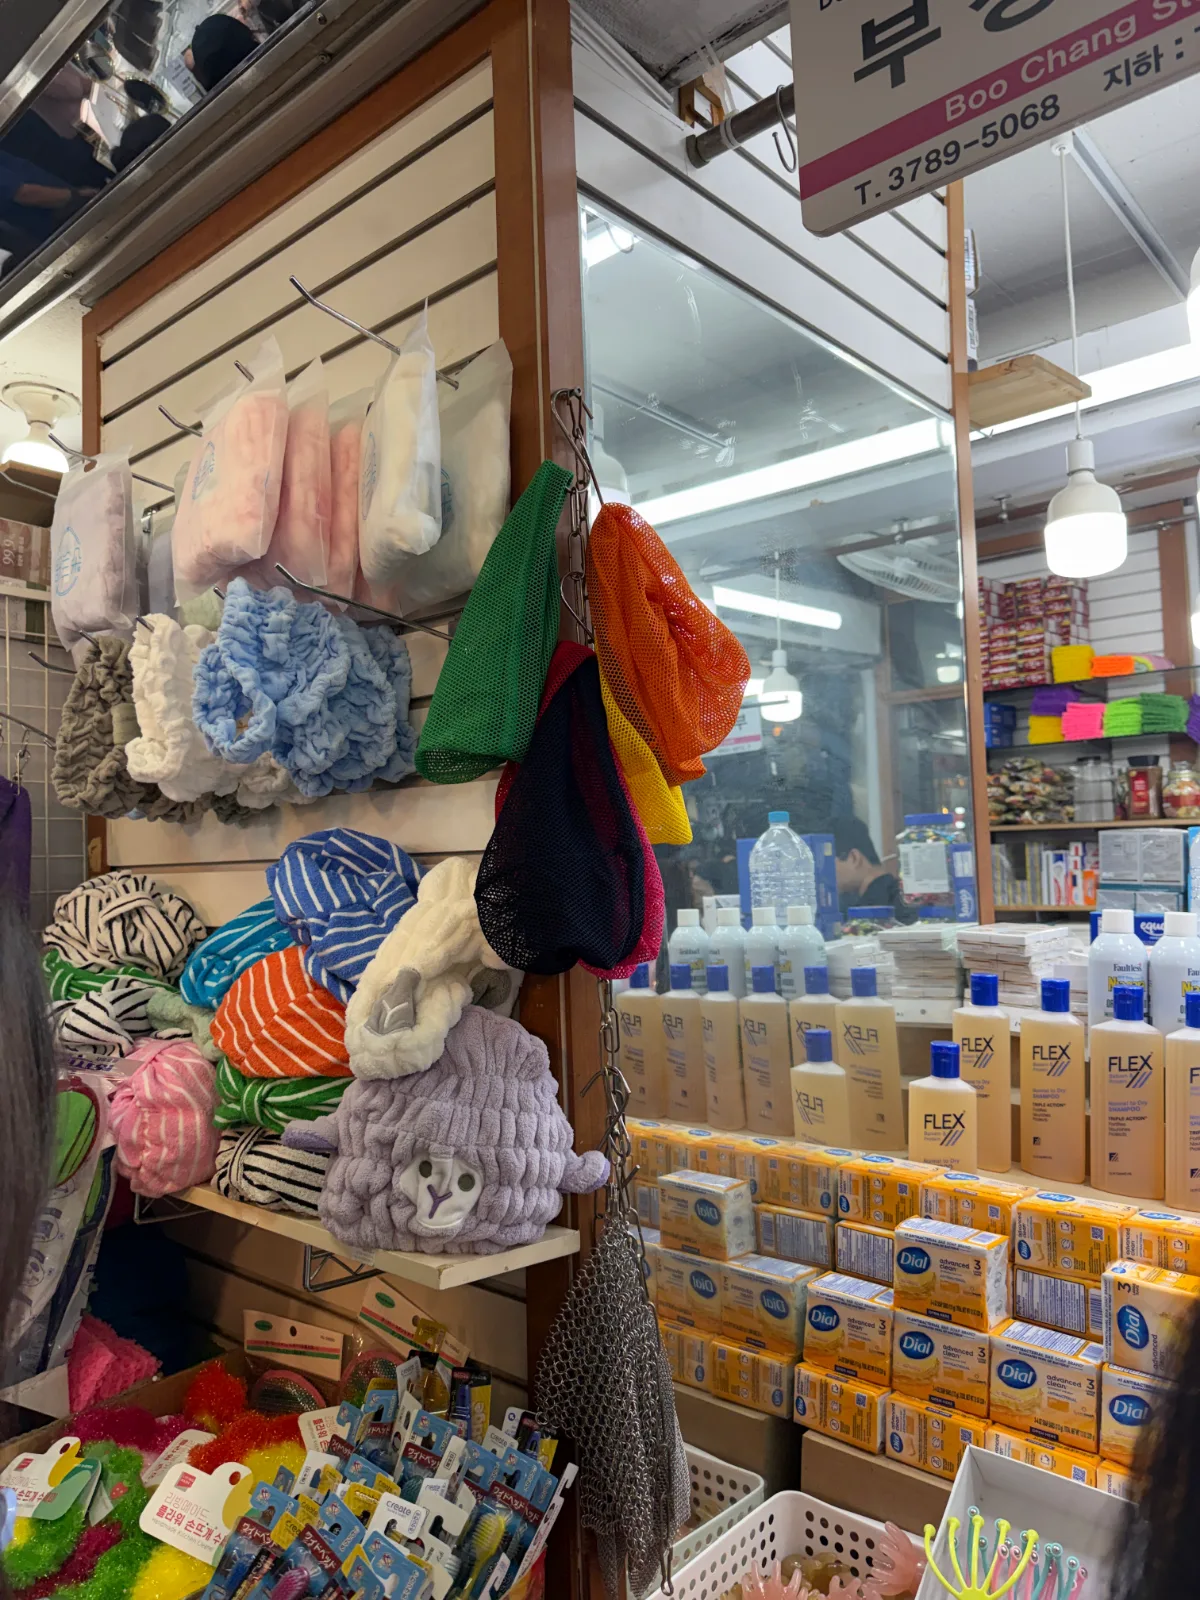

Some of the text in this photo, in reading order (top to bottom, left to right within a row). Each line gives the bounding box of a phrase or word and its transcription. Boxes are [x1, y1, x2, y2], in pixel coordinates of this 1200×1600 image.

[944, 80, 1008, 122] Boo
[1020, 14, 1137, 84] Chang
[1103, 44, 1164, 92] 지하
[854, 94, 1061, 206] T. 3789-5068
[1113, 963, 1142, 972] Faultless
[961, 1036, 994, 1052] FLEX
[1032, 1045, 1071, 1060] FLEX
[1108, 1055, 1153, 1072] FLEX
[924, 1113, 966, 1129] FLEX
[900, 1251, 928, 1269] Dial
[939, 1258, 970, 1269] advanced
[939, 1264, 957, 1272] clean
[974, 1260, 981, 1270] 3
[1117, 1283, 1132, 1293] 3
[811, 1309, 837, 1327] Dial
[847, 1317, 875, 1329] advanced
[879, 1319, 886, 1330] 3
[1125, 1309, 1141, 1346] Dial
[902, 1335, 931, 1355] Dial
[942, 1344, 974, 1356] advanced
[978, 1346, 986, 1358] 3
[942, 1350, 960, 1359] clean
[1001, 1364, 1033, 1384] Dial
[1046, 1375, 1082, 1388] advanced
[1046, 1380, 1067, 1390] clean
[1086, 1378, 1095, 1390] 3
[1112, 1400, 1149, 1420] Dial
[164, 1491, 210, 1523] 리빙메이드
[385, 1500, 412, 1516] create
[156, 1504, 186, 1527] 플라워
[184, 1519, 215, 1541] 손뜨개
